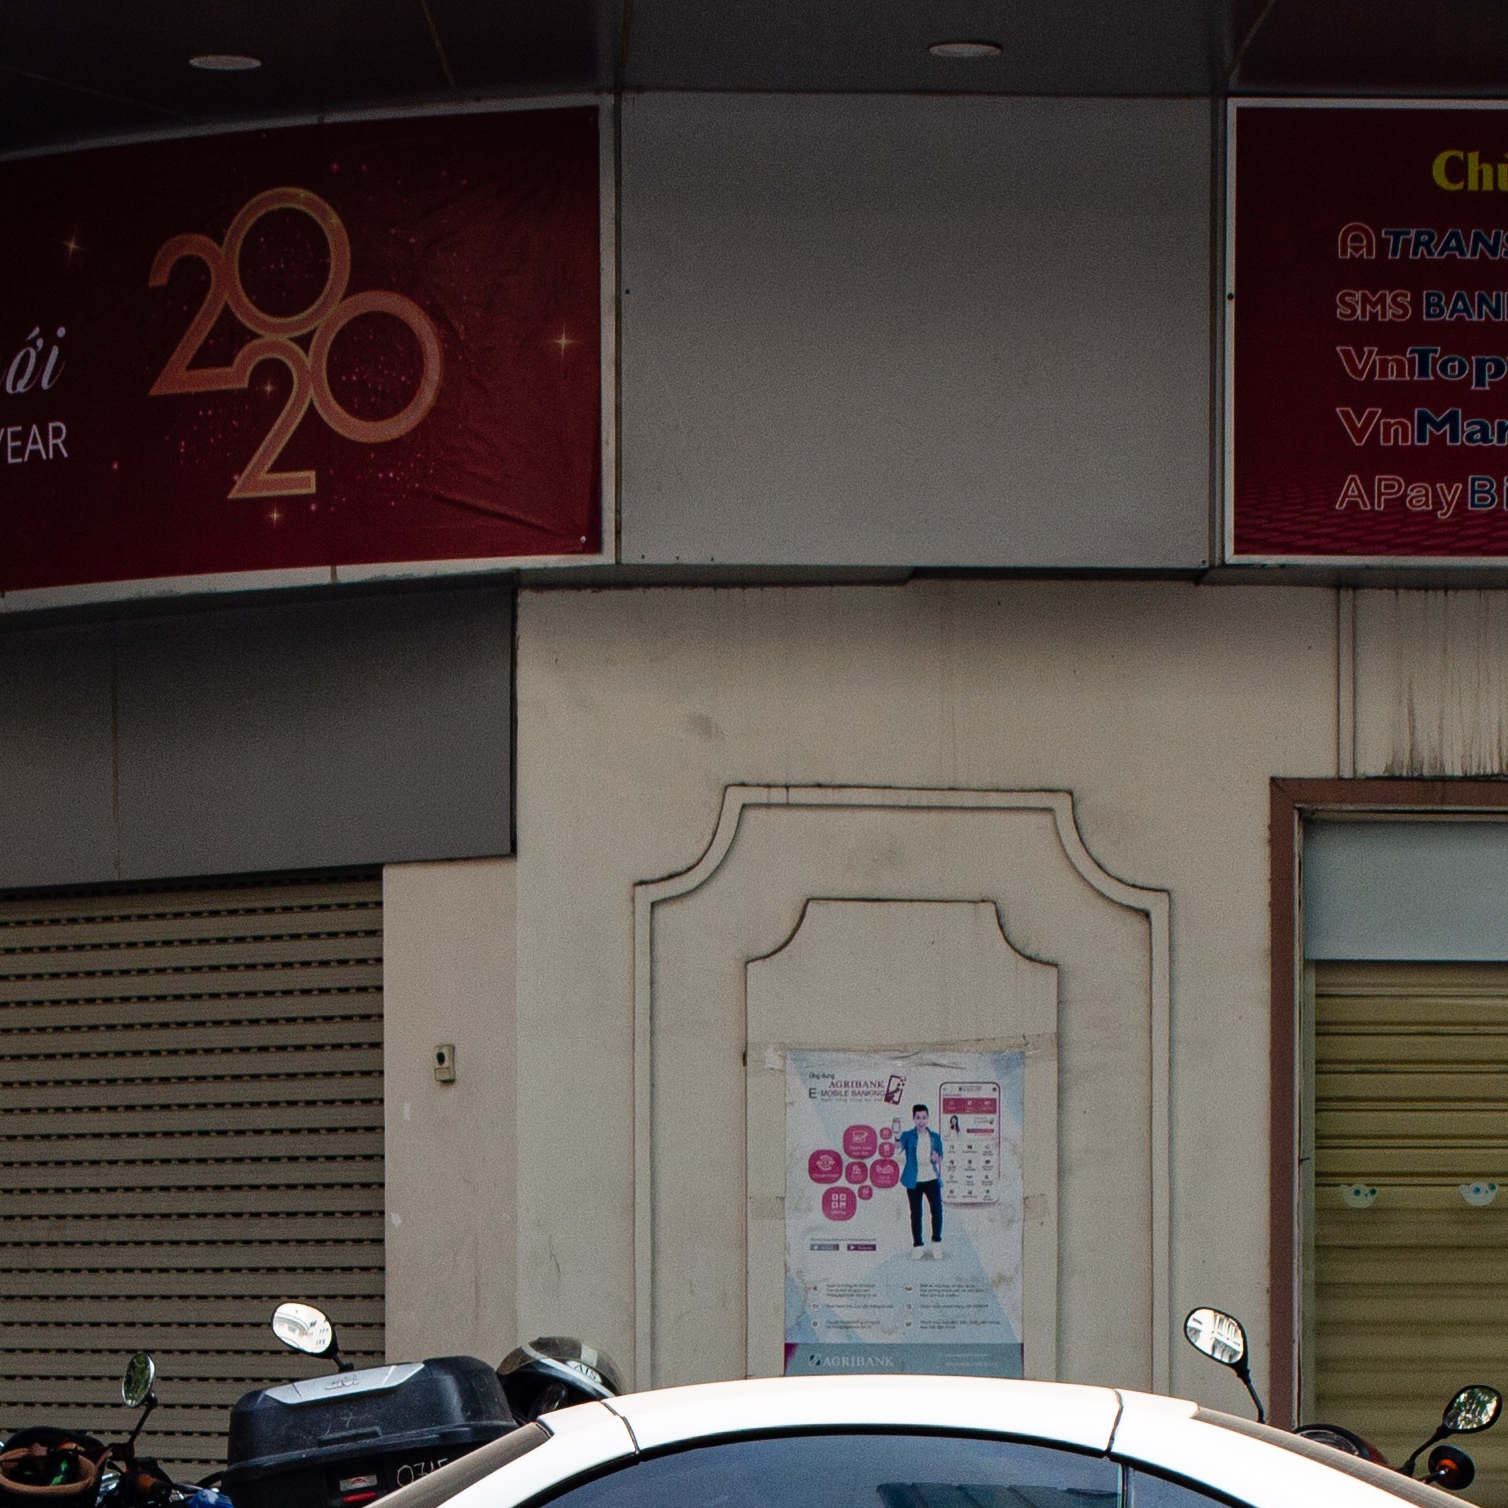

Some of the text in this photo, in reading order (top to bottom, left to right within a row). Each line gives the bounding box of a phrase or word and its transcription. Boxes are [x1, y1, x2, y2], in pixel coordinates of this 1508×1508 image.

[1335, 289, 1412, 322] SMS
[828, 1079, 885, 1089] AGRIBANK
[822, 1355, 894, 1367] AGRIBANK
